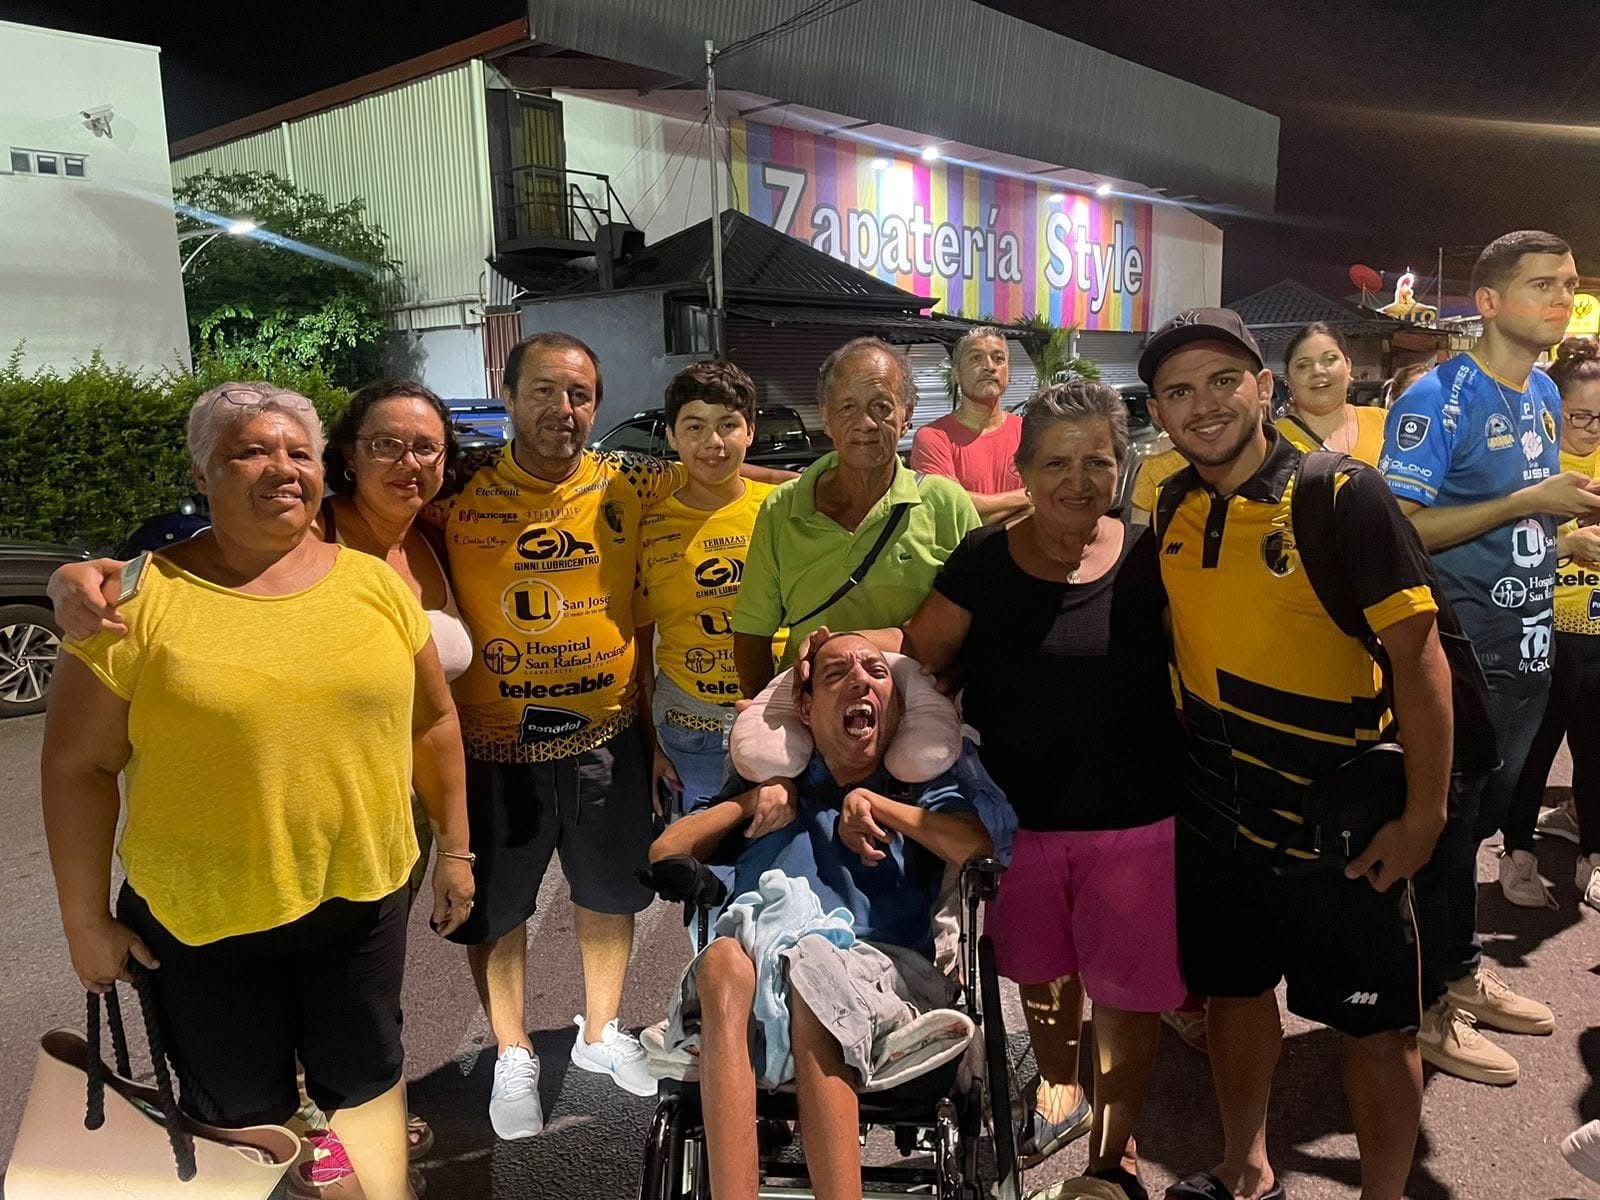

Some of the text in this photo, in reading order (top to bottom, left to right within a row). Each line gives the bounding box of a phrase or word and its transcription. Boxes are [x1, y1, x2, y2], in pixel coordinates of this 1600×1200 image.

[762, 162, 1143, 313] Zapatería Style
[514, 555, 600, 571] GINNI LUBRICENTRO
[562, 600, 584, 610] San
[588, 592, 610, 609] José
[526, 636, 591, 657] Hospital
[525, 658, 549, 669] San
[553, 653, 592, 669] Rafael
[499, 672, 616, 699] telecable
